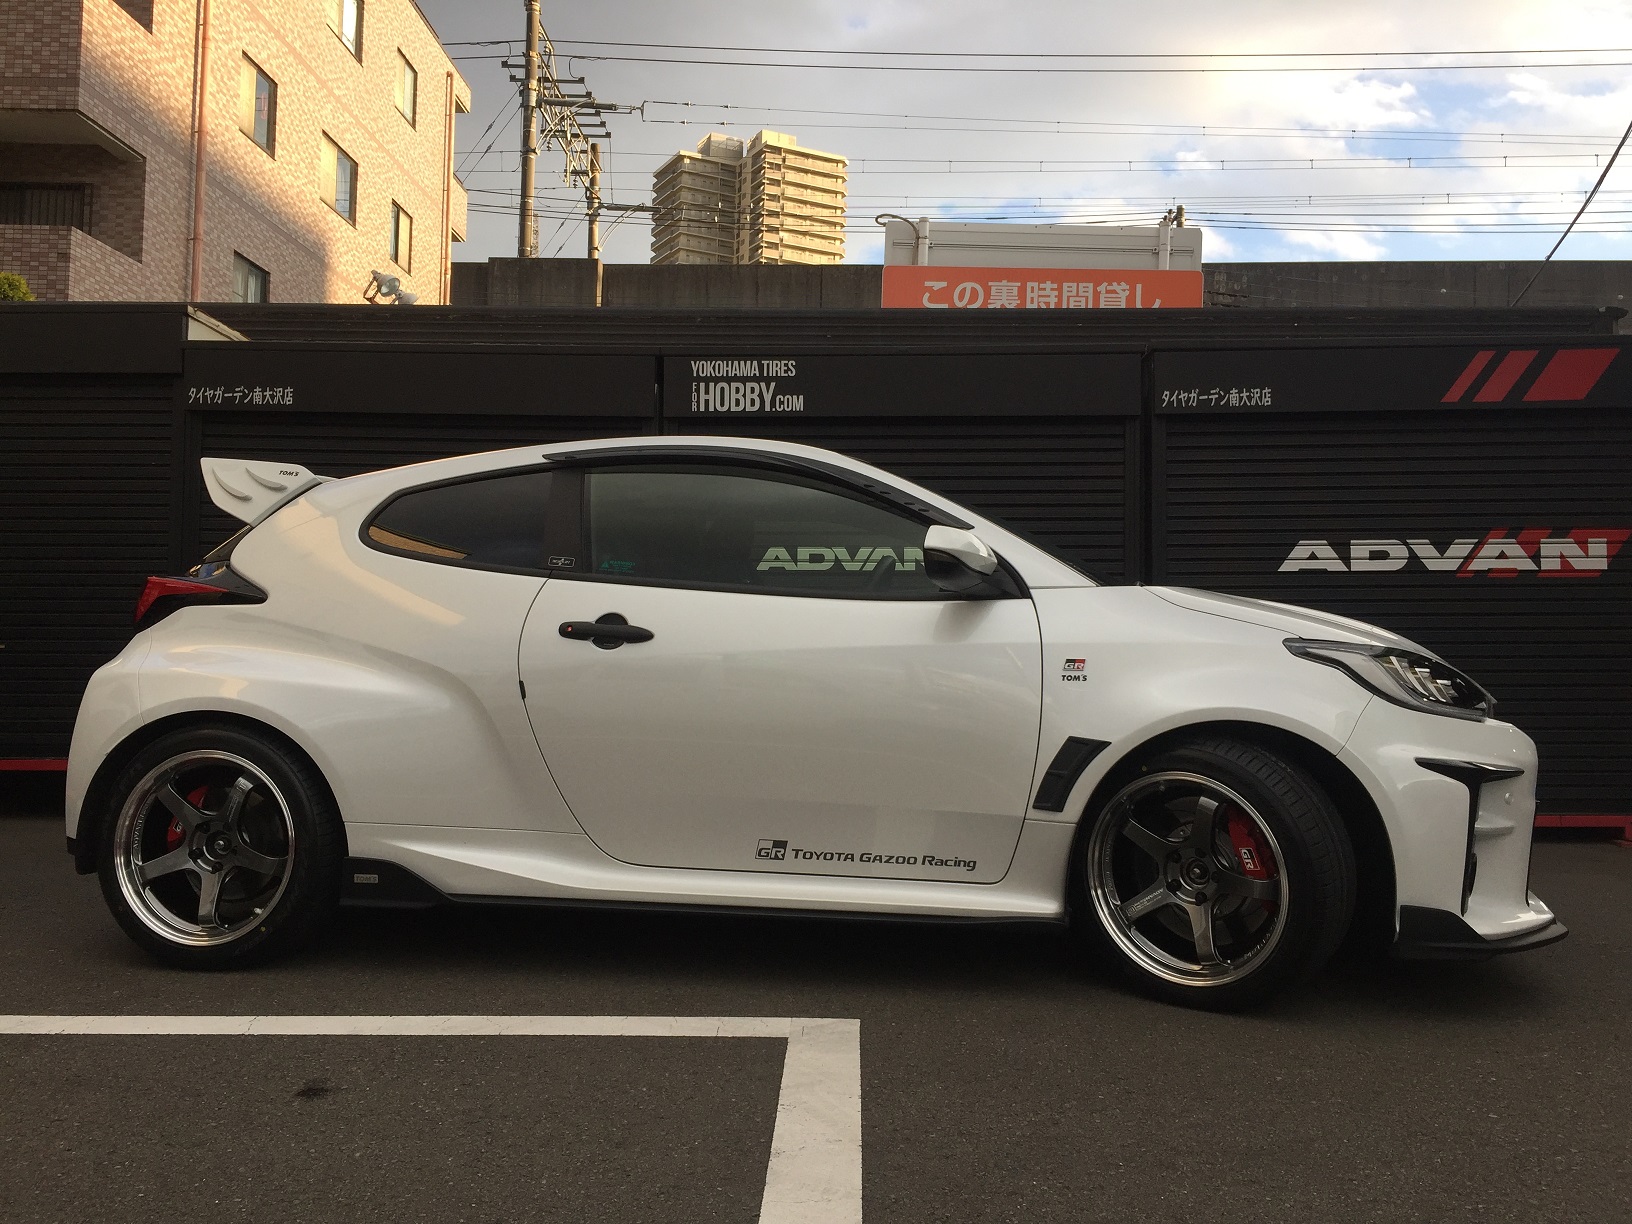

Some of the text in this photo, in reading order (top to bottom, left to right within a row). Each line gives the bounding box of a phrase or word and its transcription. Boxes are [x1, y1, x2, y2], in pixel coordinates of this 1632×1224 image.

[691, 360, 796, 377] YOKOHAMA TIRES
[188, 385, 294, 405] タイヤガーデン南大沢店
[699, 381, 804, 412] HOBBY.COM
[1161, 386, 1272, 408] タイヤガーデン南大沢店
[1277, 538, 1608, 572] ADVAN
[1063, 660, 1085, 670] GR
[1061, 674, 1088, 682] TOM'S
[756, 845, 977, 872] GR TOYOTA GAZOO Racing
[1240, 848, 1256, 870] GR
